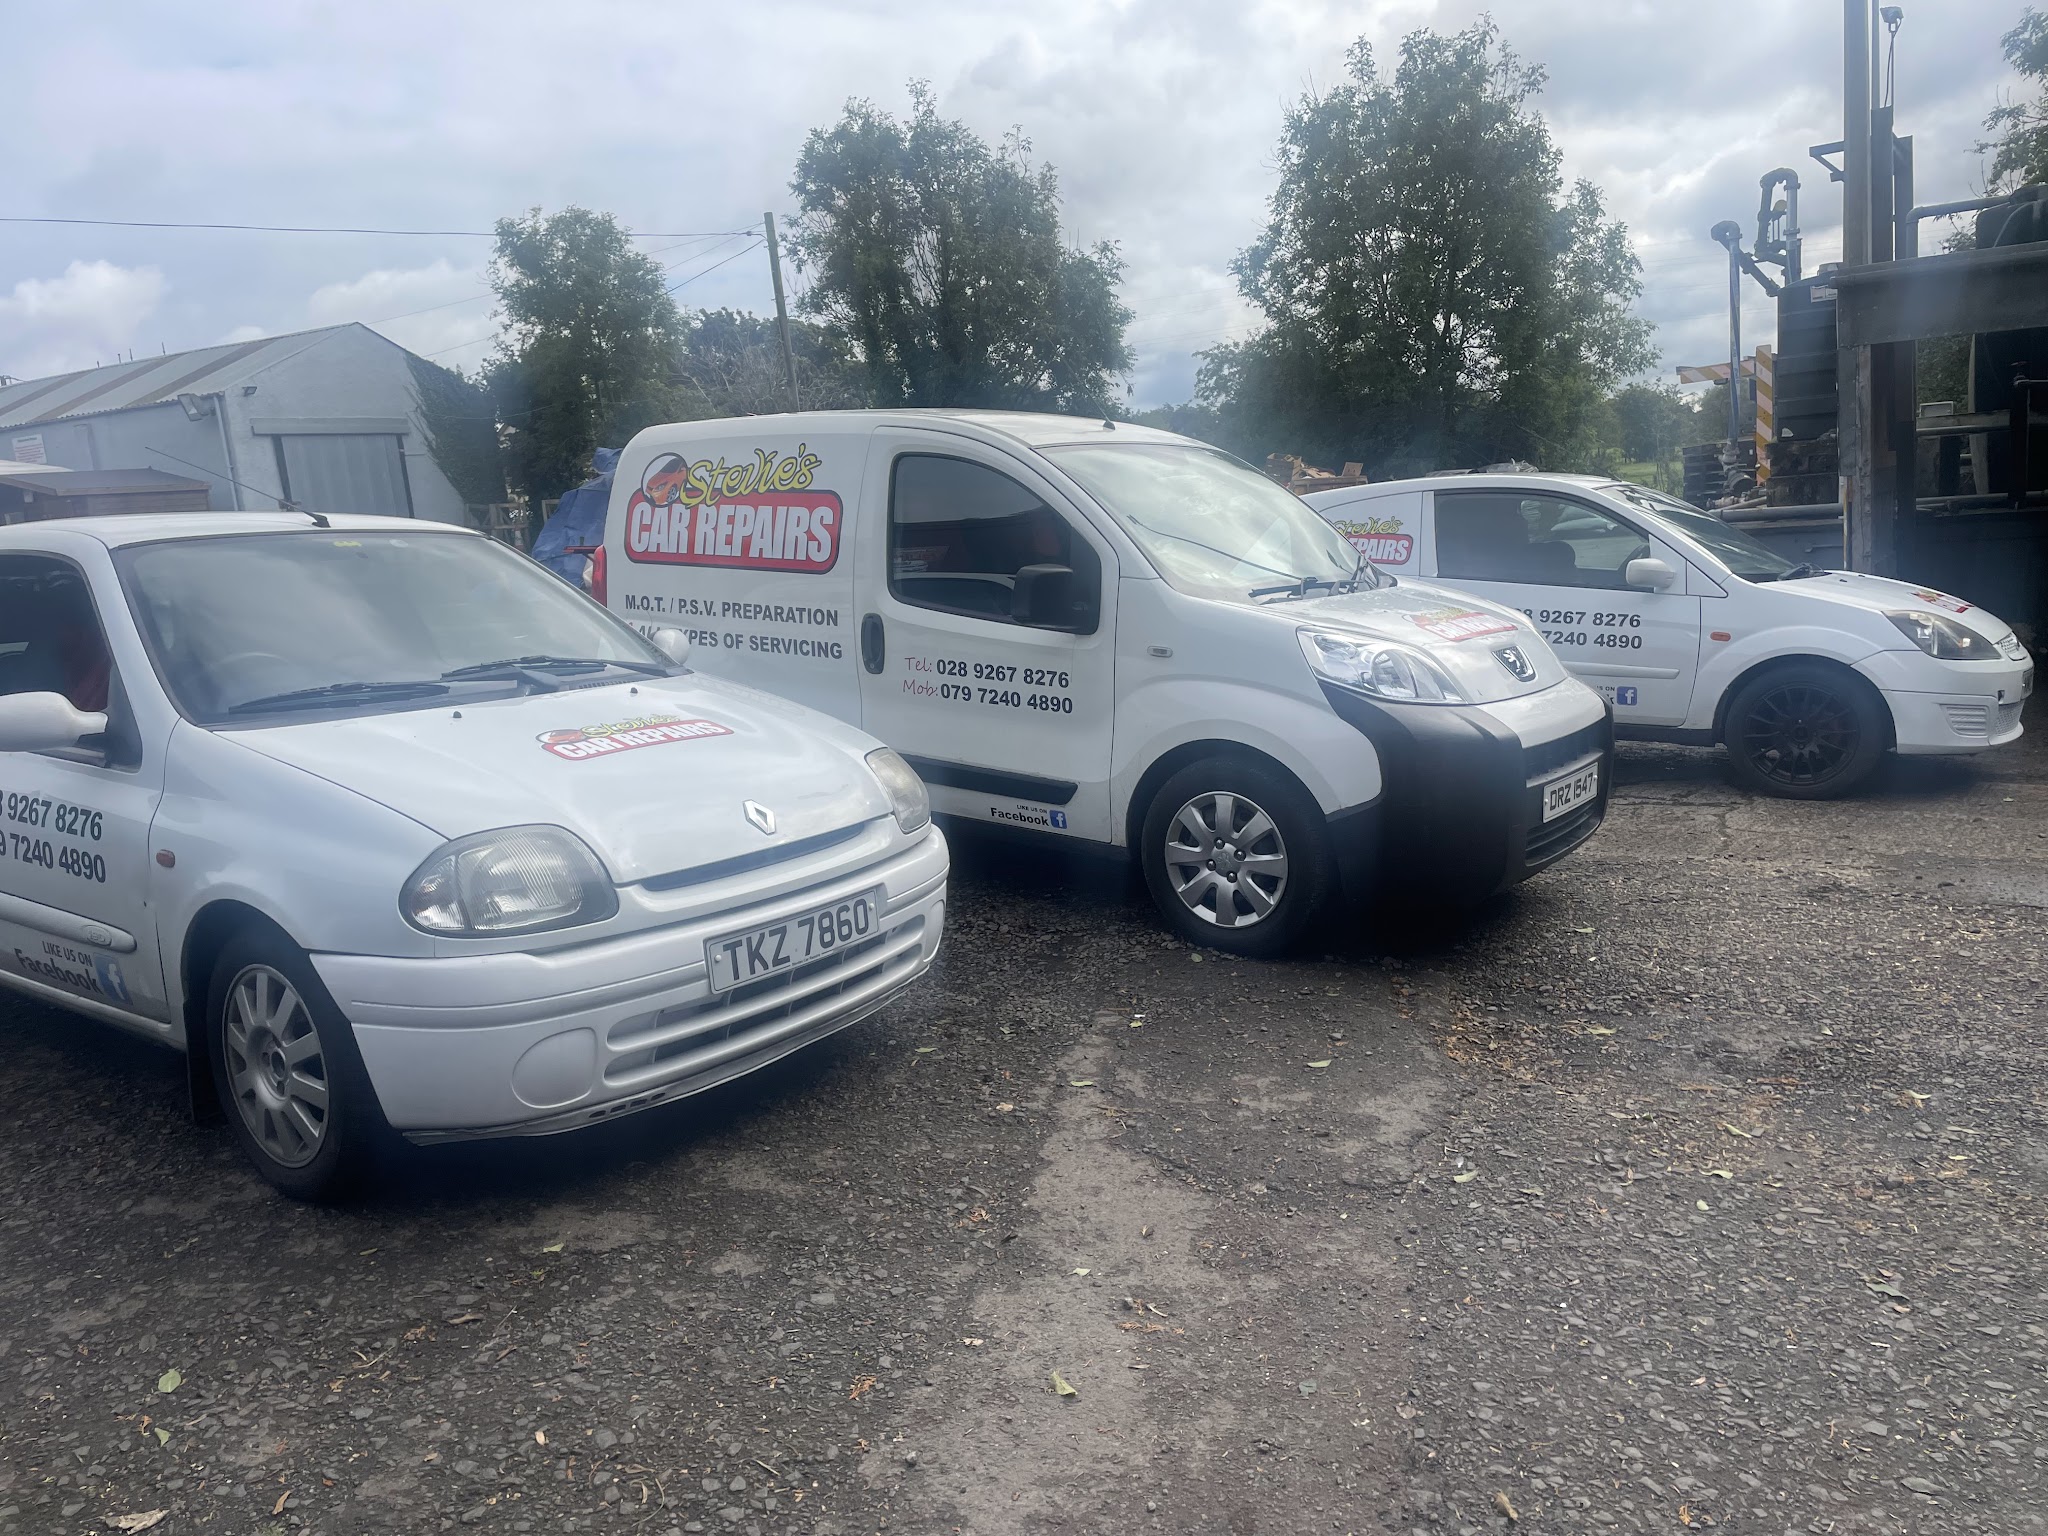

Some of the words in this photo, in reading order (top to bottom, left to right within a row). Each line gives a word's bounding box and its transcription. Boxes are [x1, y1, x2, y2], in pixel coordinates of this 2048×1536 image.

[678, 443, 822, 509] Stevie's
[630, 503, 690, 554] CAR
[694, 503, 833, 563] REPAIRS
[625, 594, 666, 613] M.O.T.
[678, 598, 717, 617] P.S.V.
[721, 601, 838, 627] PREPARATION
[1539, 609, 1587, 625] 9267
[1592, 612, 1641, 628] 8276
[723, 632, 744, 650] OF
[749, 635, 842, 660] SERVICING
[1593, 633, 1642, 649] 4890
[904, 657, 932, 673] Tel:
[936, 659, 968, 677] 028
[973, 663, 1017, 683] 9267
[1023, 668, 1069, 688] 8276
[902, 679, 938, 697] Mob:
[940, 683, 972, 702] 079
[977, 688, 1021, 708] 7240
[1026, 693, 1073, 714] 4890
[553, 737, 624, 758] CAR
[609, 721, 726, 746] REPAIRS
[1550, 783, 1571, 811] DRZ
[1573, 772, 1594, 800] 1547
[7, 792, 52, 828] 9267
[55, 804, 103, 841] 8276
[990, 807, 1050, 827] Facebook
[10, 833, 54, 869] 7240
[59, 846, 106, 883] 4890
[42, 941, 62, 957] LIKE
[63, 947, 76, 962] US
[78, 952, 93, 967] ON
[723, 925, 790, 981] TKZ
[798, 898, 869, 956] 7860
[14, 948, 104, 996] Facebook
